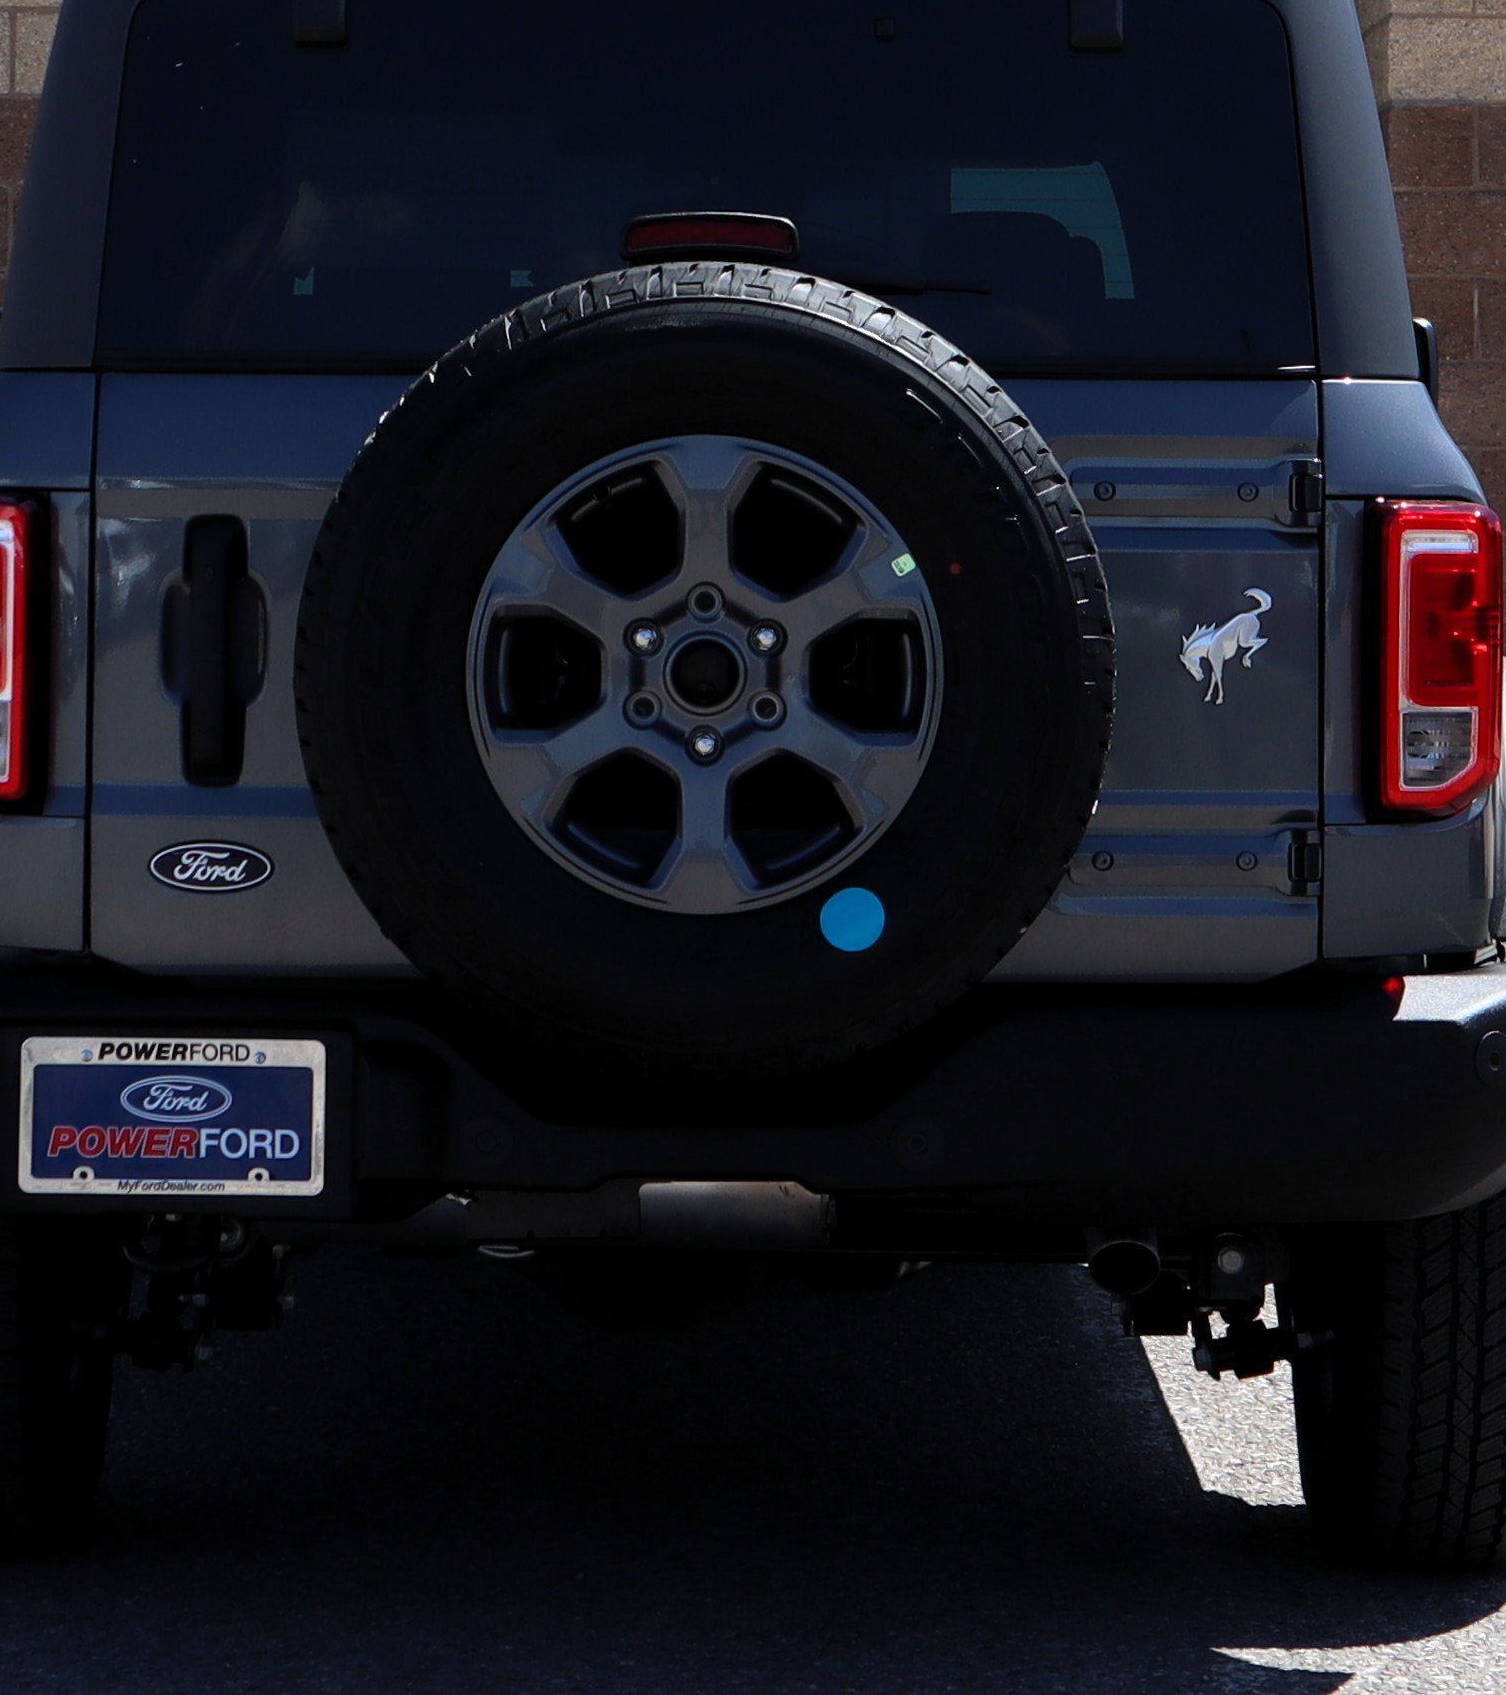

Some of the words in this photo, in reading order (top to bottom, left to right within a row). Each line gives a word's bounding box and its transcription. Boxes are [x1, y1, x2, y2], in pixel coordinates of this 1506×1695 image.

[173, 849, 247, 882] Ford
[97, 1041, 251, 1061] POWERFORD
[142, 1083, 209, 1112] Ford
[47, 1124, 300, 1159] POWERFORD
[116, 1179, 226, 1193] MyFordDealer.com
